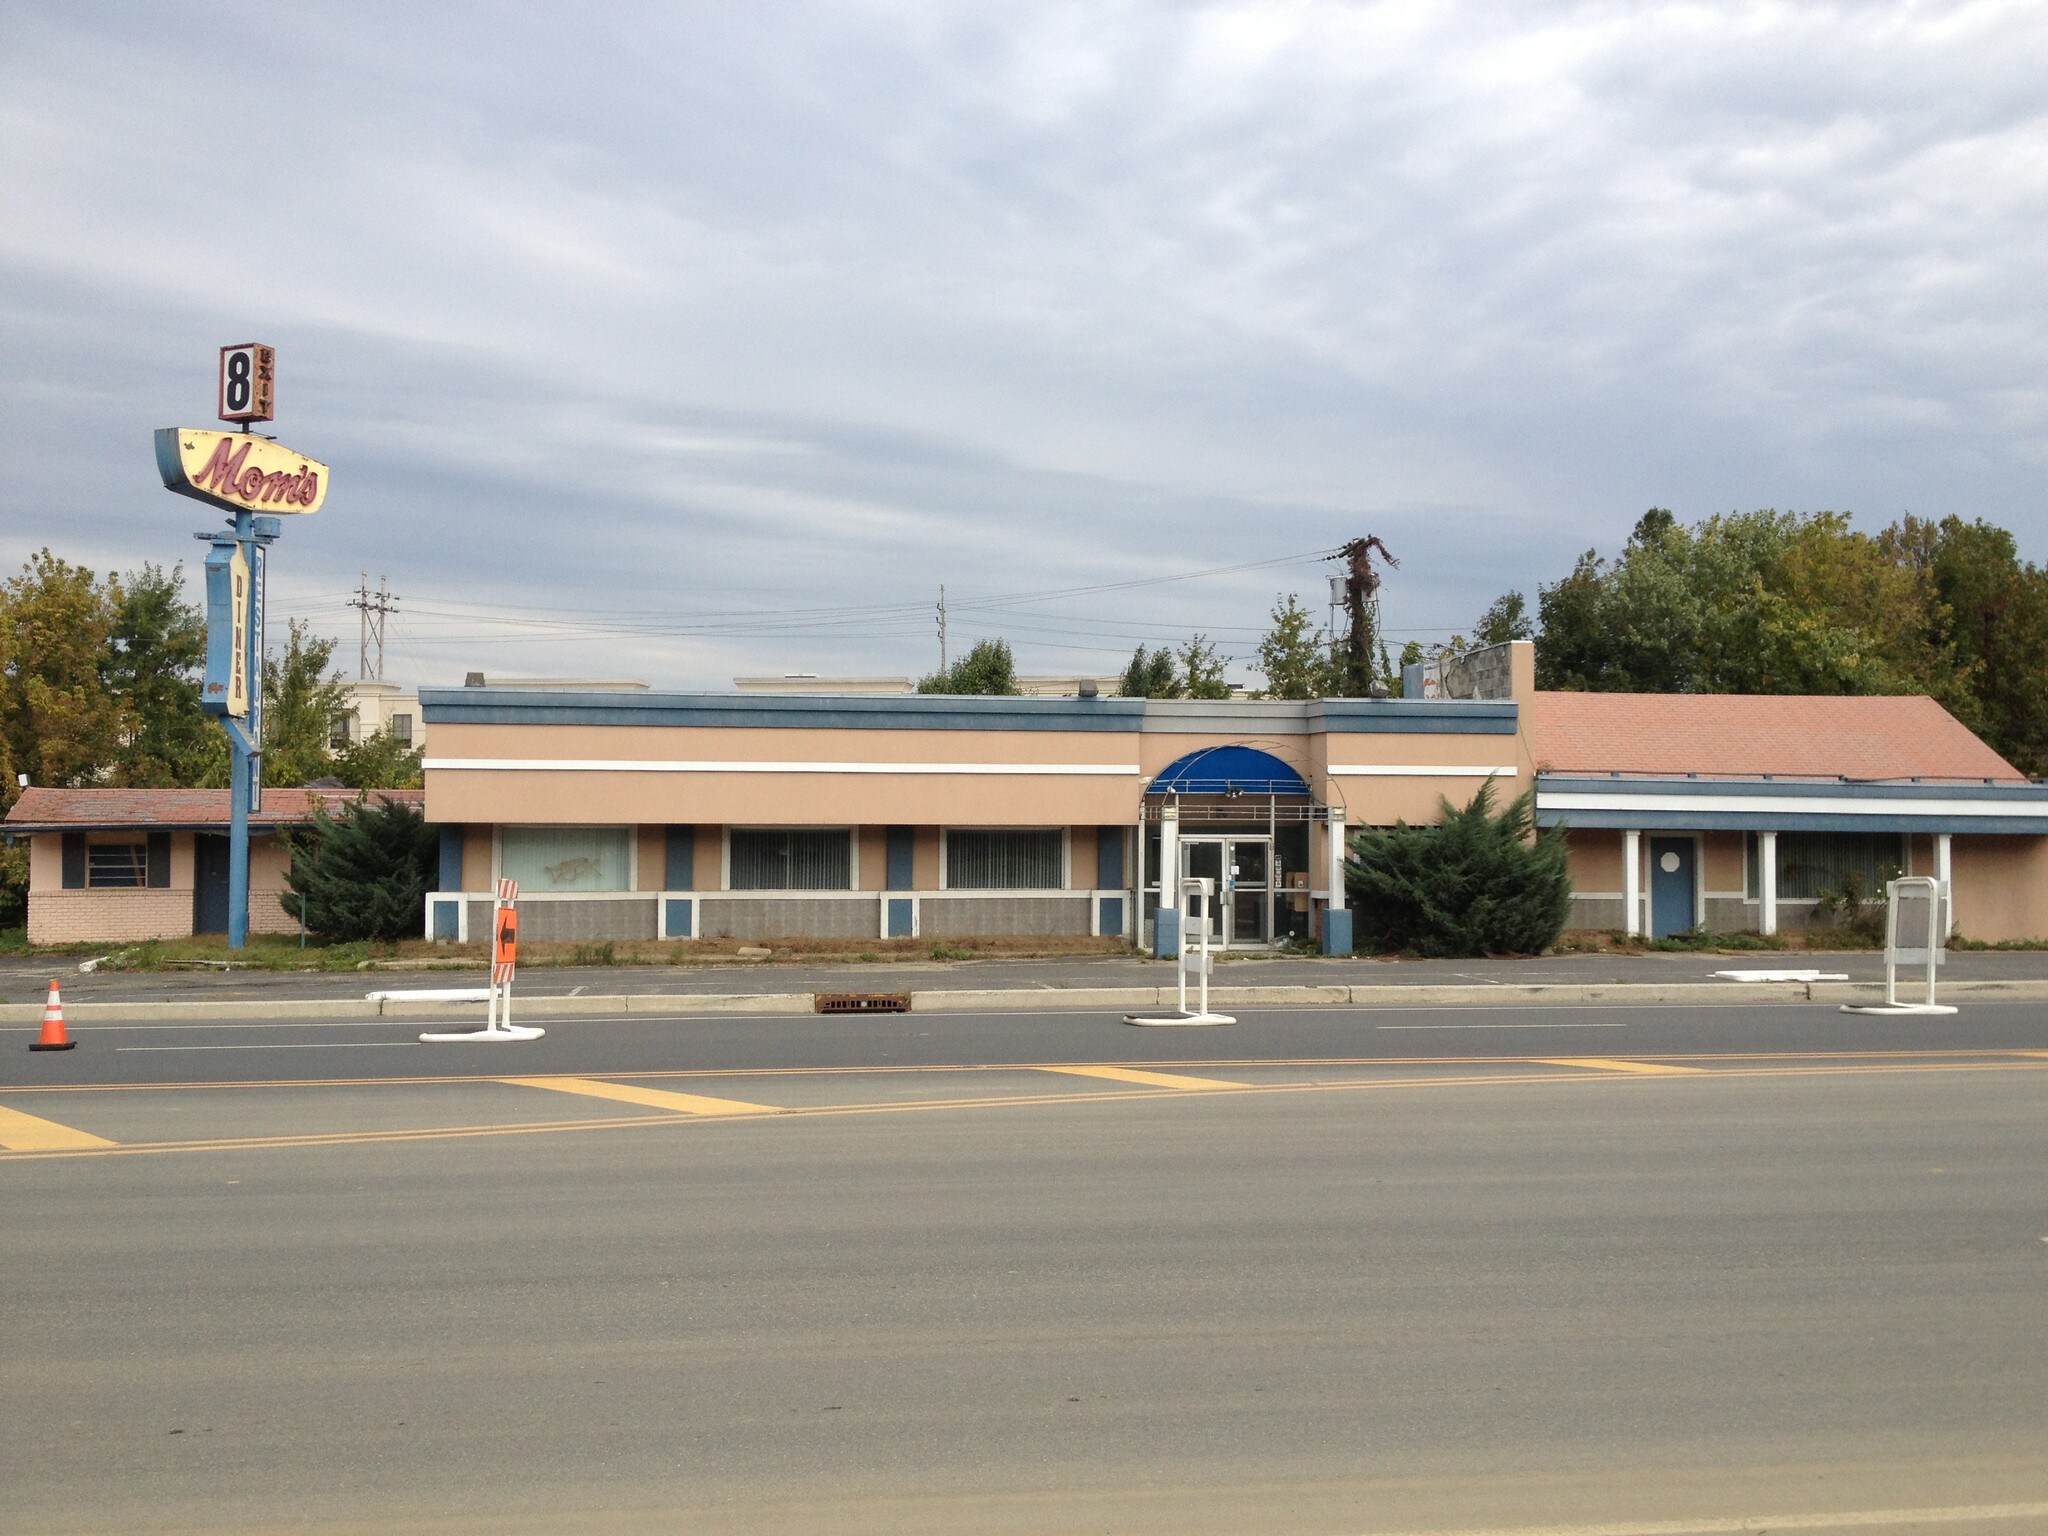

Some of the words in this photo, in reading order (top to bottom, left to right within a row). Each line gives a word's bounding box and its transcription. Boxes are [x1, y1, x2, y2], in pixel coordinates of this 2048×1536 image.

[227, 352, 250, 411] 8
[258, 348, 272, 414] EXIT
[192, 437, 318, 506] Mom's
